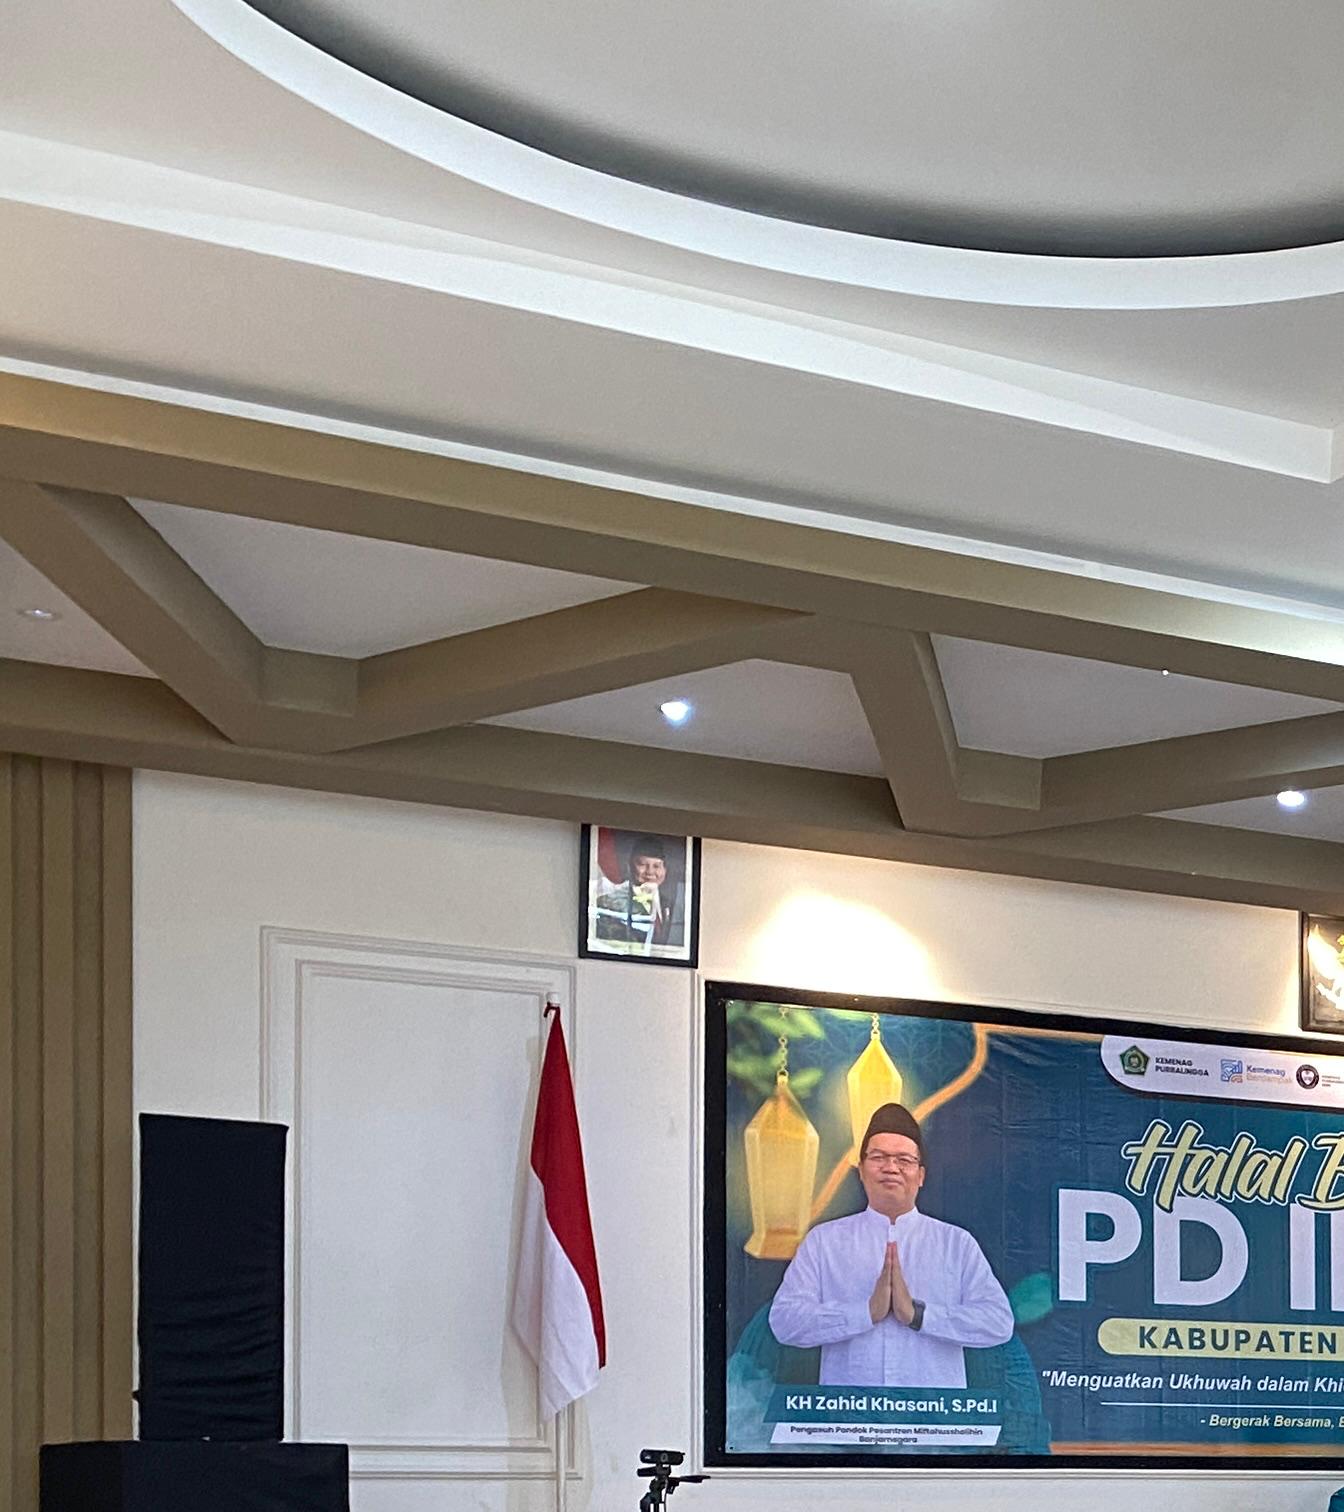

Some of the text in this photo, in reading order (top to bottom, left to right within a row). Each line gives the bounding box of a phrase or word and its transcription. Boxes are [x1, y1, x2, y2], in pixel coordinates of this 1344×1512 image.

[1122, 1119, 1307, 1213] Halal
[1058, 1187, 1249, 1307] PD
[1137, 1325, 1337, 1356] KABUPATEN
[1169, 1373, 1251, 1391] Ukhuwah
[1257, 1375, 1309, 1392] dalam
[786, 1395, 811, 1410] KH
[815, 1396, 867, 1411] Zahid
[871, 1397, 949, 1415] Khasani,
[1209, 1415, 1270, 1428] Bergerak
[1273, 1416, 1335, 1430] Bersama,
